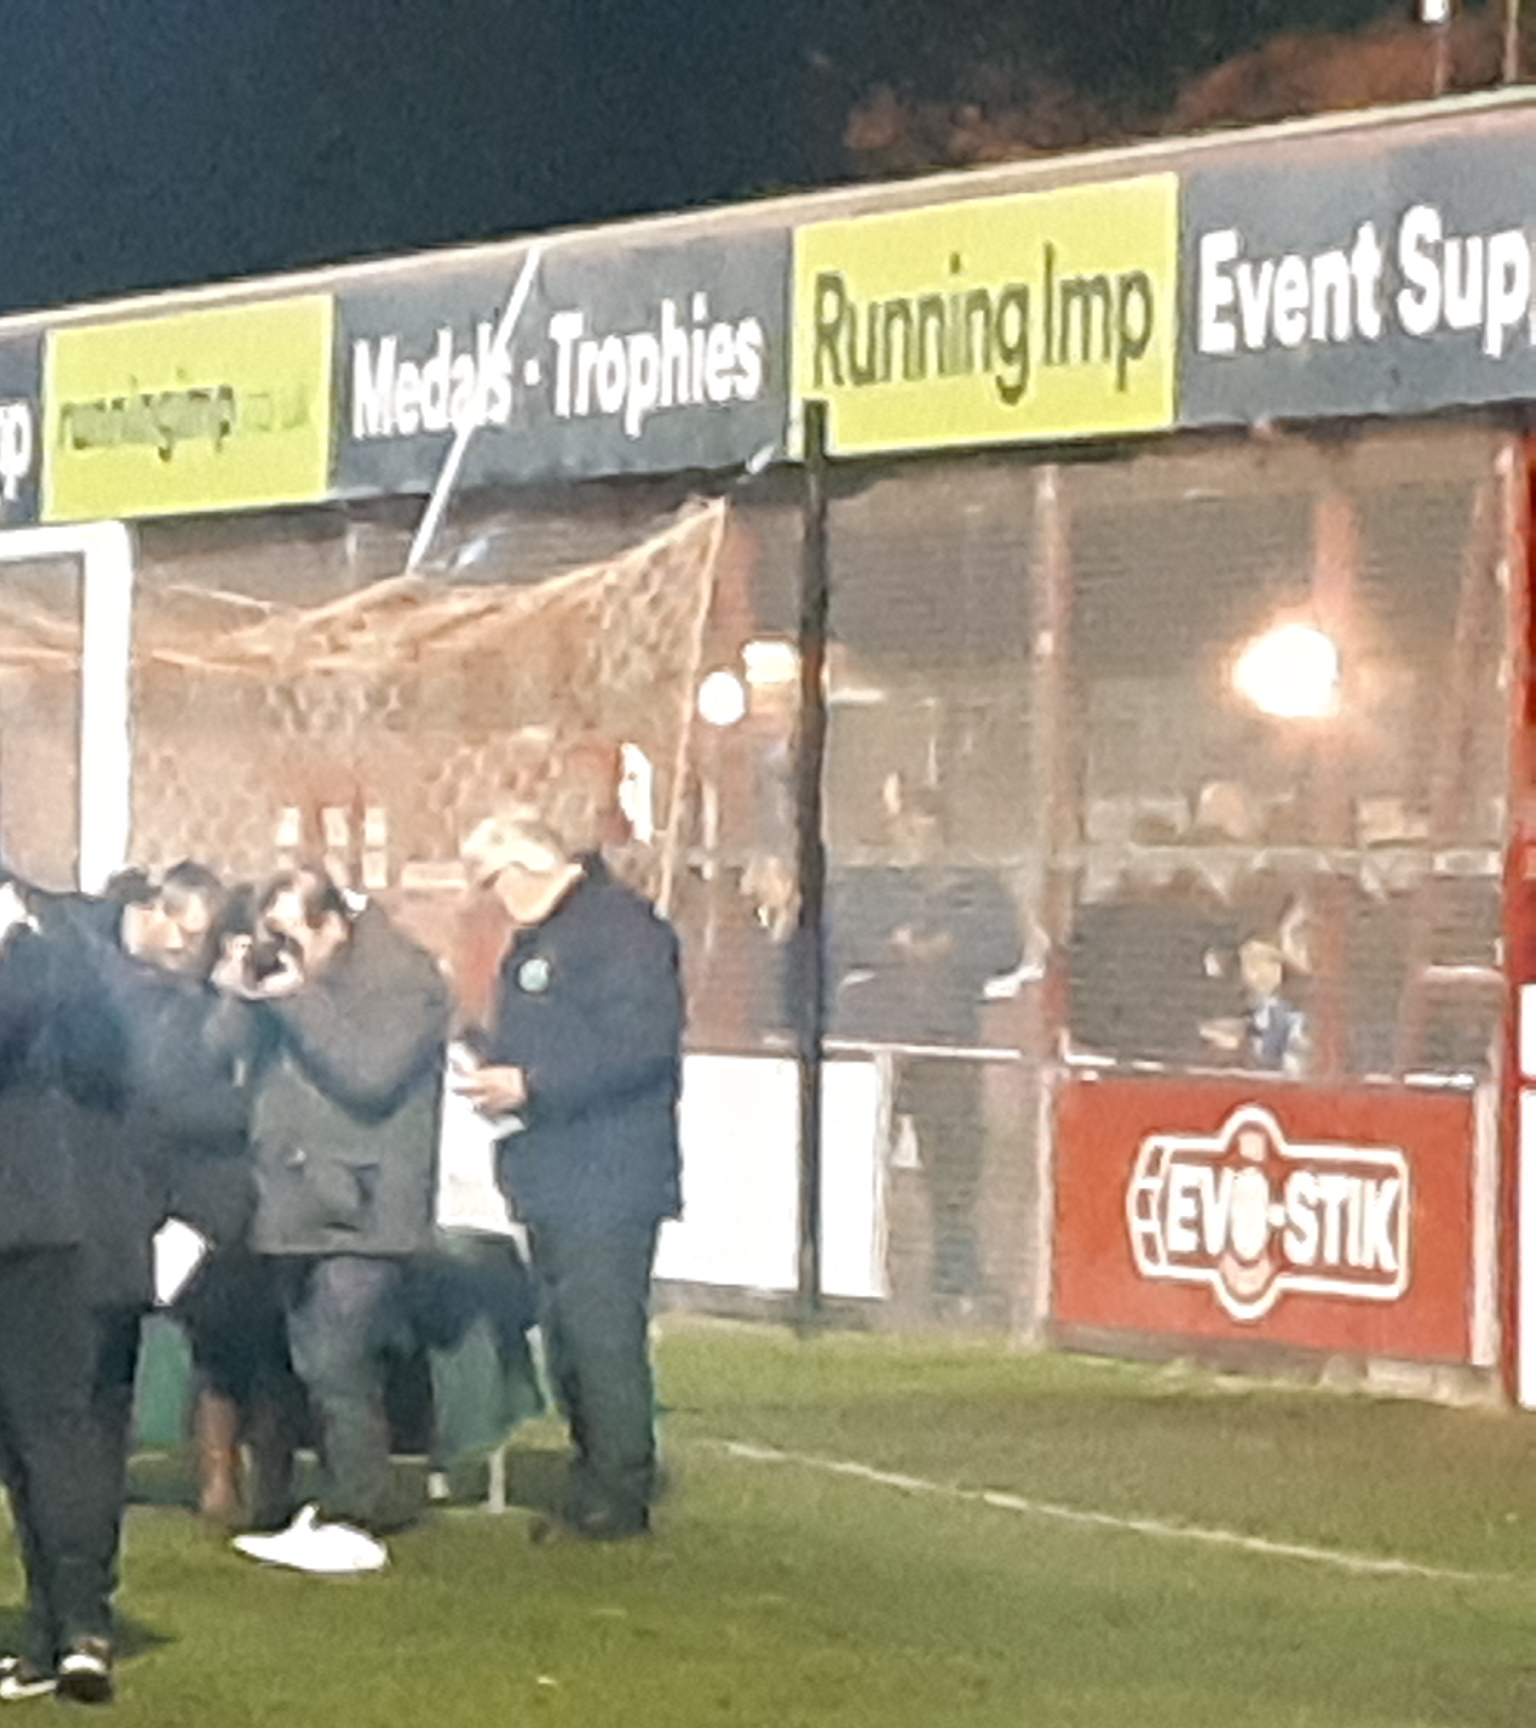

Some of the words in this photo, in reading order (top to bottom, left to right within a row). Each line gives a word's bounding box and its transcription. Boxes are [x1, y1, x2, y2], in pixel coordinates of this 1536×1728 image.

[1198, 219, 1383, 354] Event
[1396, 204, 1536, 359] Sup
[352, 321, 513, 439] Medals
[548, 291, 764, 438] Trophies
